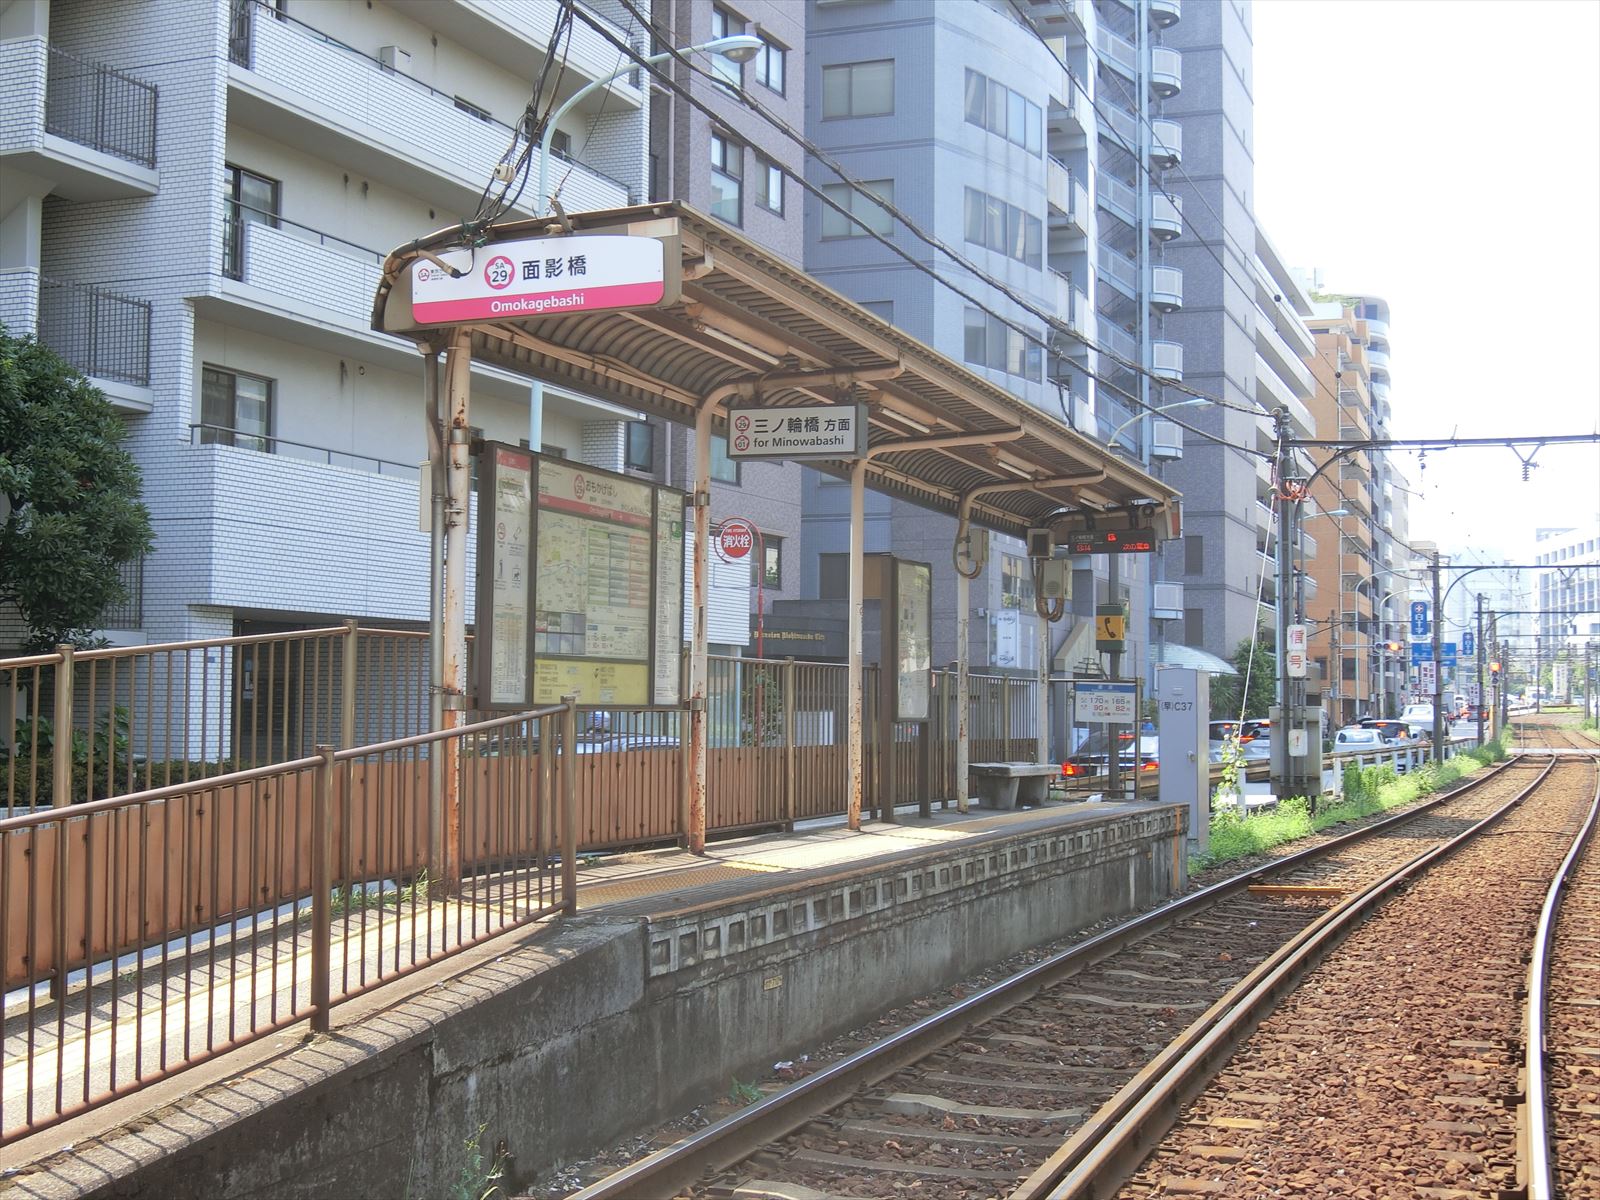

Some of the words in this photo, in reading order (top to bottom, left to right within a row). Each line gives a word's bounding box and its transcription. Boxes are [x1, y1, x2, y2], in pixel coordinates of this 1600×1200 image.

[495, 262, 505, 270] SA
[522, 254, 587, 281] 面影橋
[492, 270, 508, 282] 29
[491, 293, 585, 313] Omokagebashi
[753, 416, 819, 434] 三ノ輪橋
[824, 418, 850, 432] 方面
[753, 438, 769, 448] for
[772, 435, 844, 448] Minowabashi
[723, 534, 751, 548] 消火栓
[1289, 630, 1304, 669] 信号
